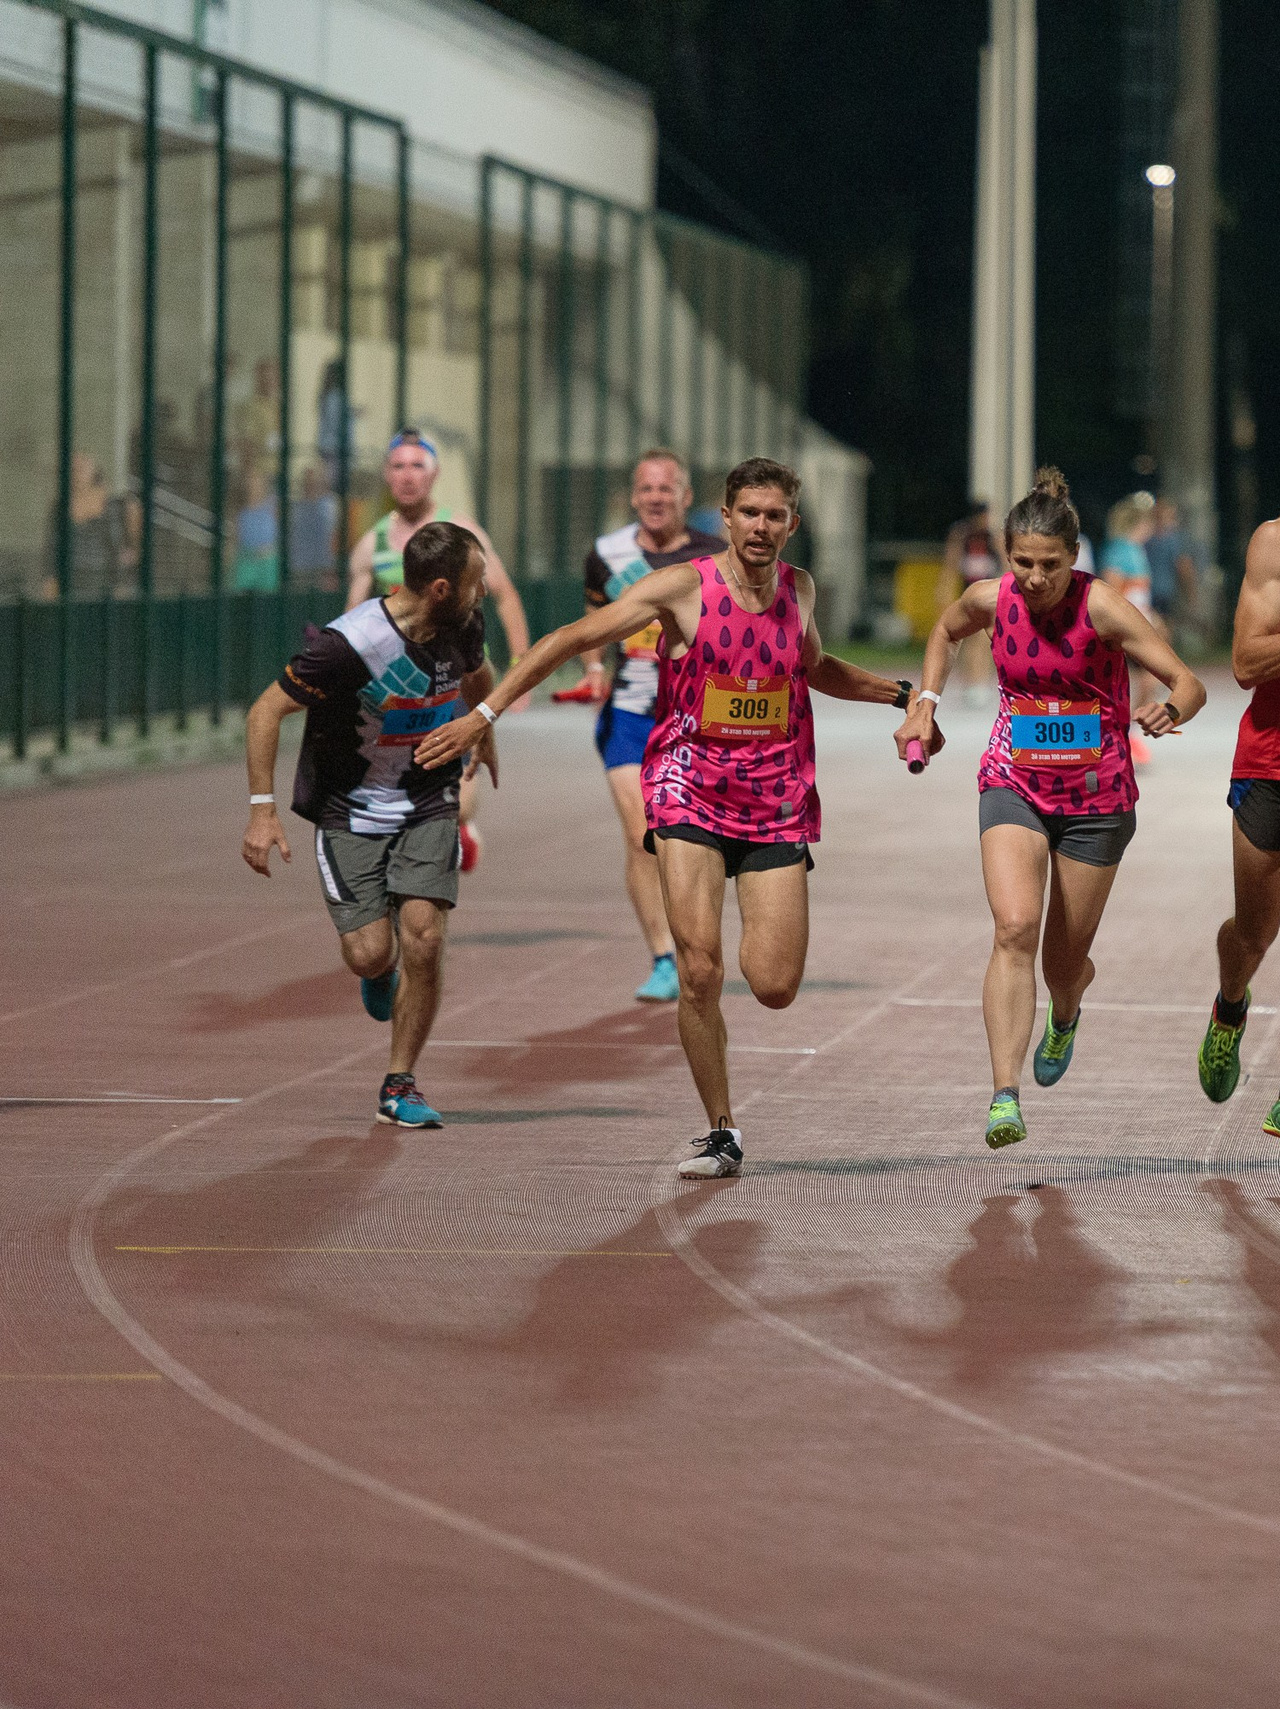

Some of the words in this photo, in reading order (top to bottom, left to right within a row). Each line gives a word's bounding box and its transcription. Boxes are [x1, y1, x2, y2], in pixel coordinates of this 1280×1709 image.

[729, 697, 769, 719] 309
[775, 706, 781, 719] 2
[405, 710, 436, 729] 310
[743, 728, 752, 736] 100
[1035, 721, 1075, 743] 309
[1083, 730, 1091, 742] 3
